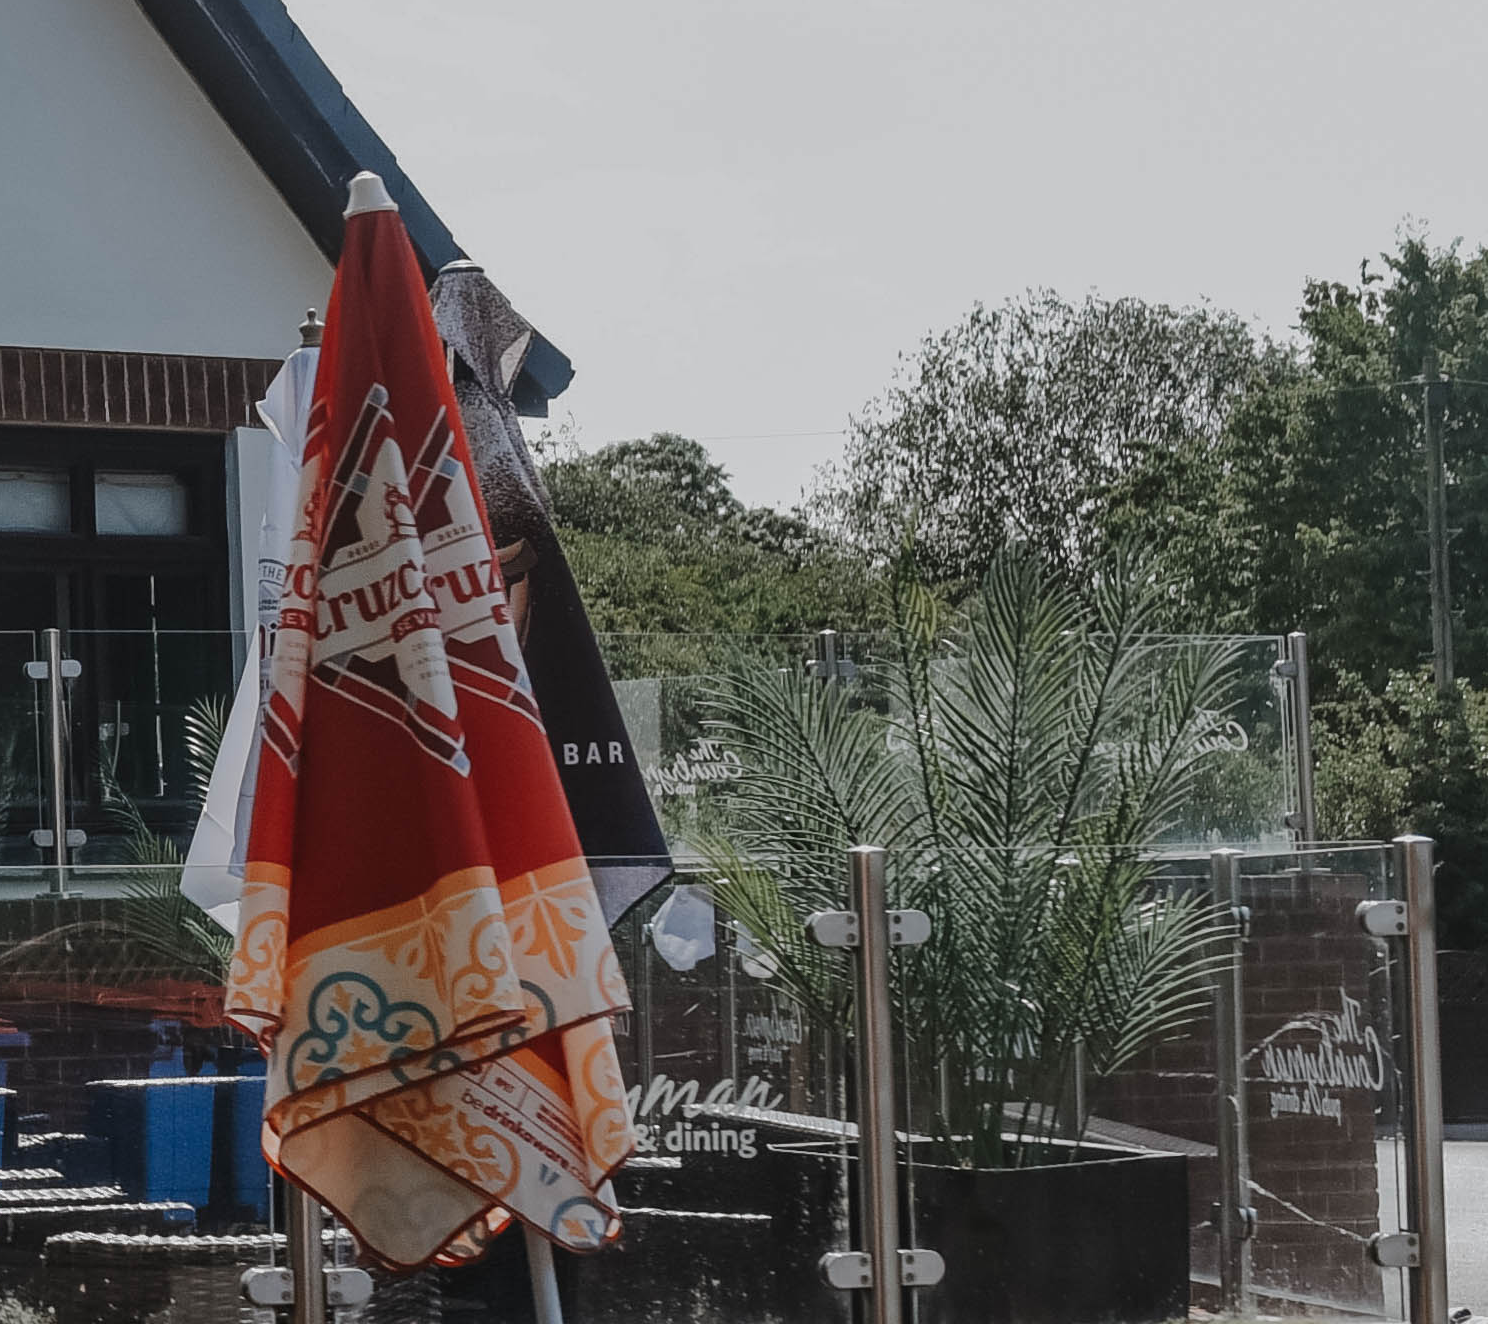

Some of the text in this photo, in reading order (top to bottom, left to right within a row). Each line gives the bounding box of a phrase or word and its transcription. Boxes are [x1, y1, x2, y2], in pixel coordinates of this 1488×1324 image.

[261, 565, 284, 581] THE
[562, 741, 625, 766] BAR
[634, 1120, 758, 1159] & dining
